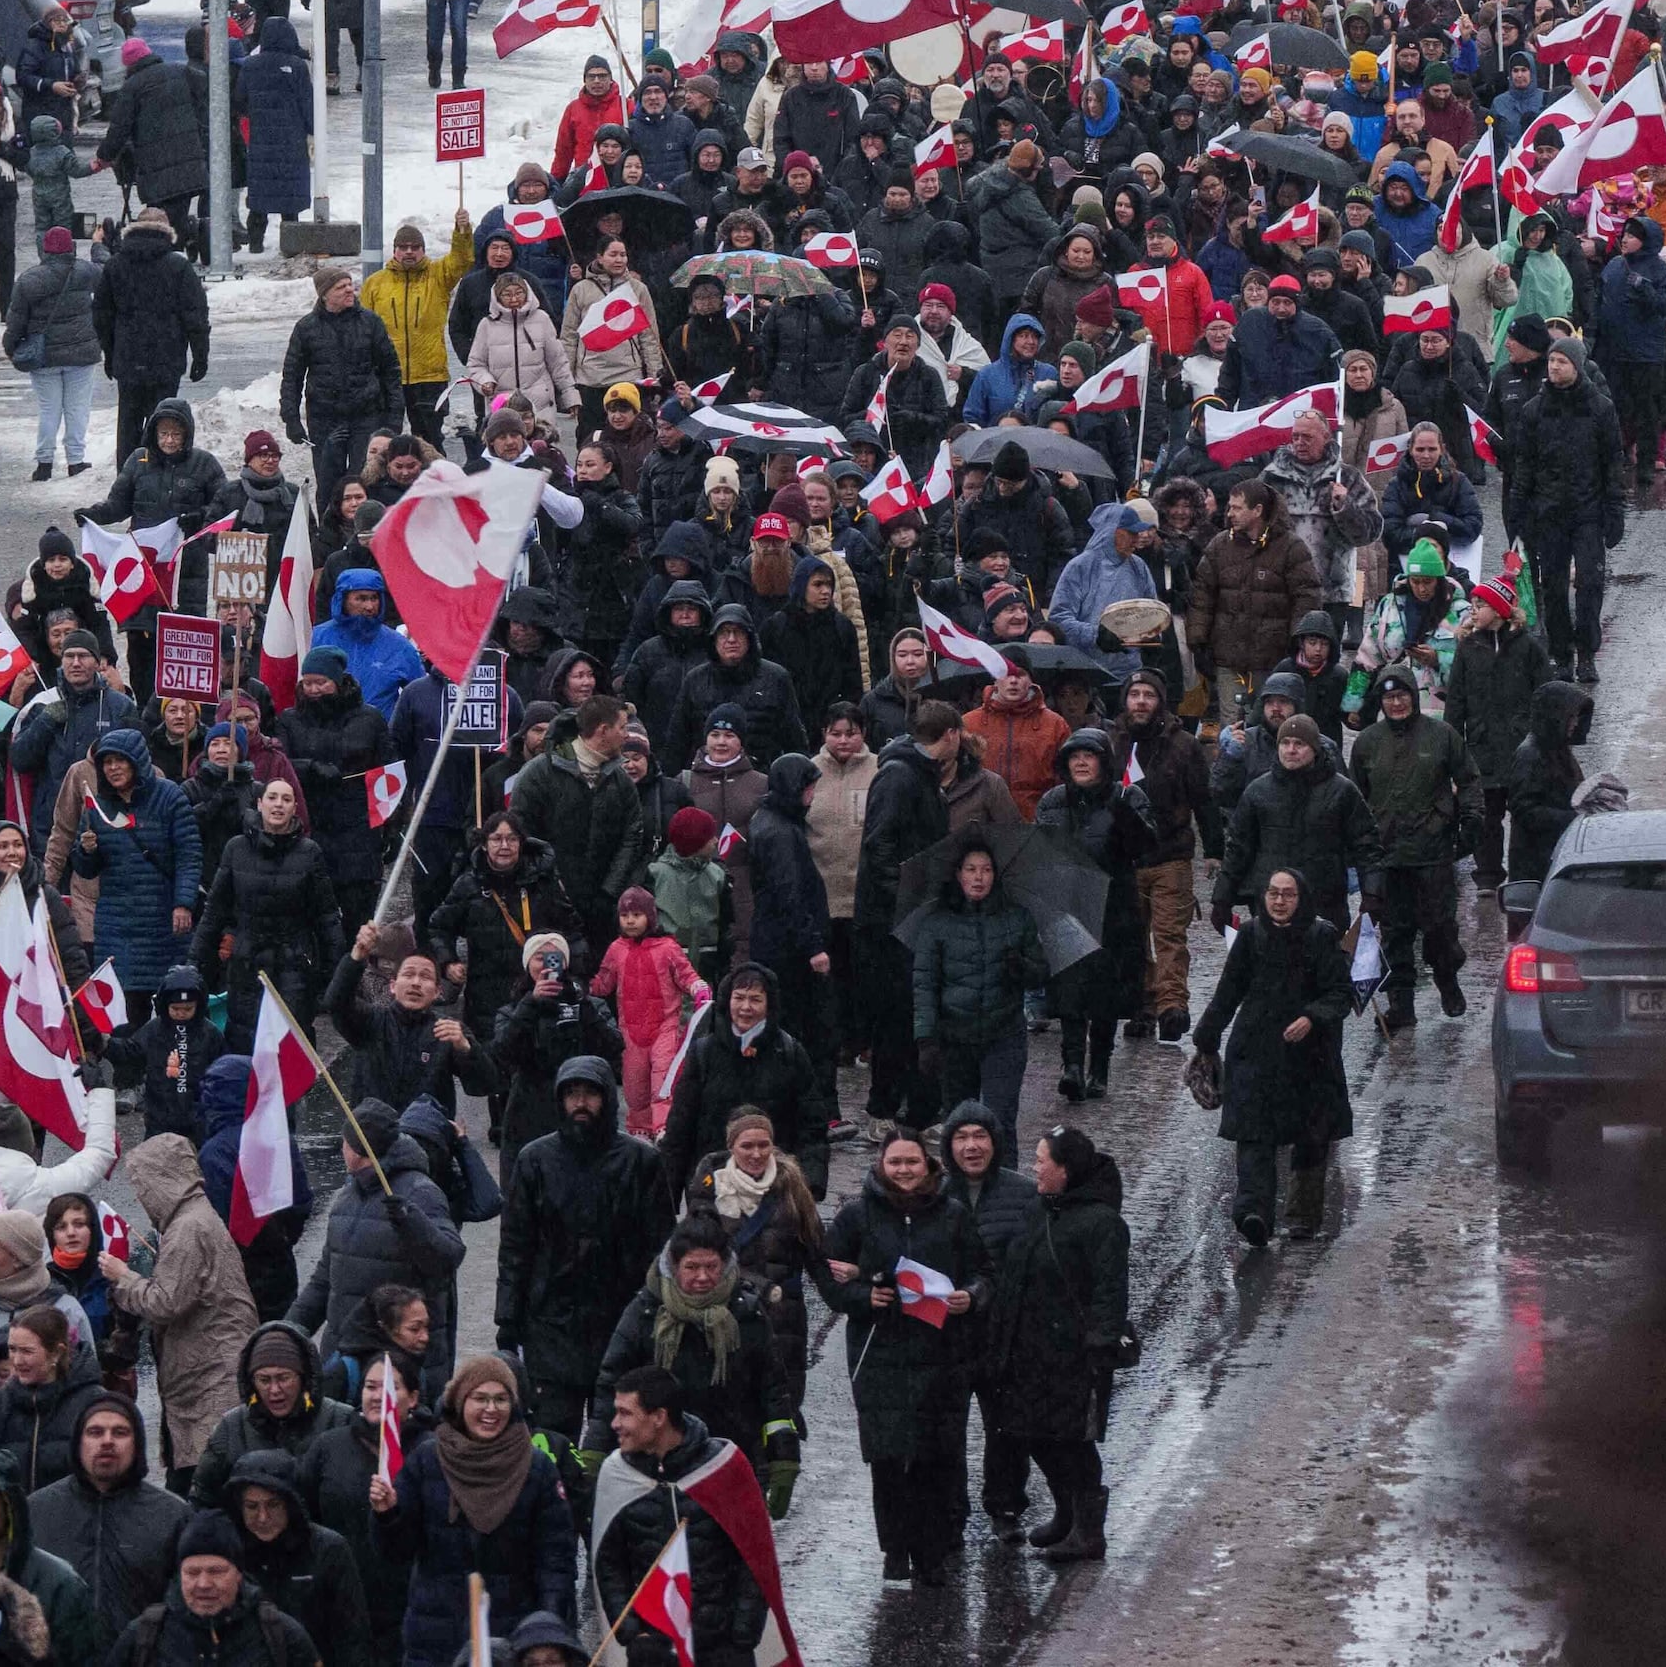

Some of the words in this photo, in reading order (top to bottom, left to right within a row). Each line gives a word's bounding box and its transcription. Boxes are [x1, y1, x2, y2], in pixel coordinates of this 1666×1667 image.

[442, 101, 479, 114] GREENLAND
[443, 117, 449, 127] IS
[451, 116, 463, 126] NOT
[467, 114, 479, 124] FOR
[442, 129, 479, 149] SALE!
[217, 570, 266, 599] NO!
[165, 630, 213, 645] GREENLAND
[165, 646, 174, 659] IS
[177, 648, 193, 660] NOT
[197, 650, 213, 663] FOR
[164, 664, 213, 691] SALE!
[449, 685, 458, 697] IS
[479, 686, 495, 698] FOR
[177, 1025, 188, 1093] DIDRIKSONS
